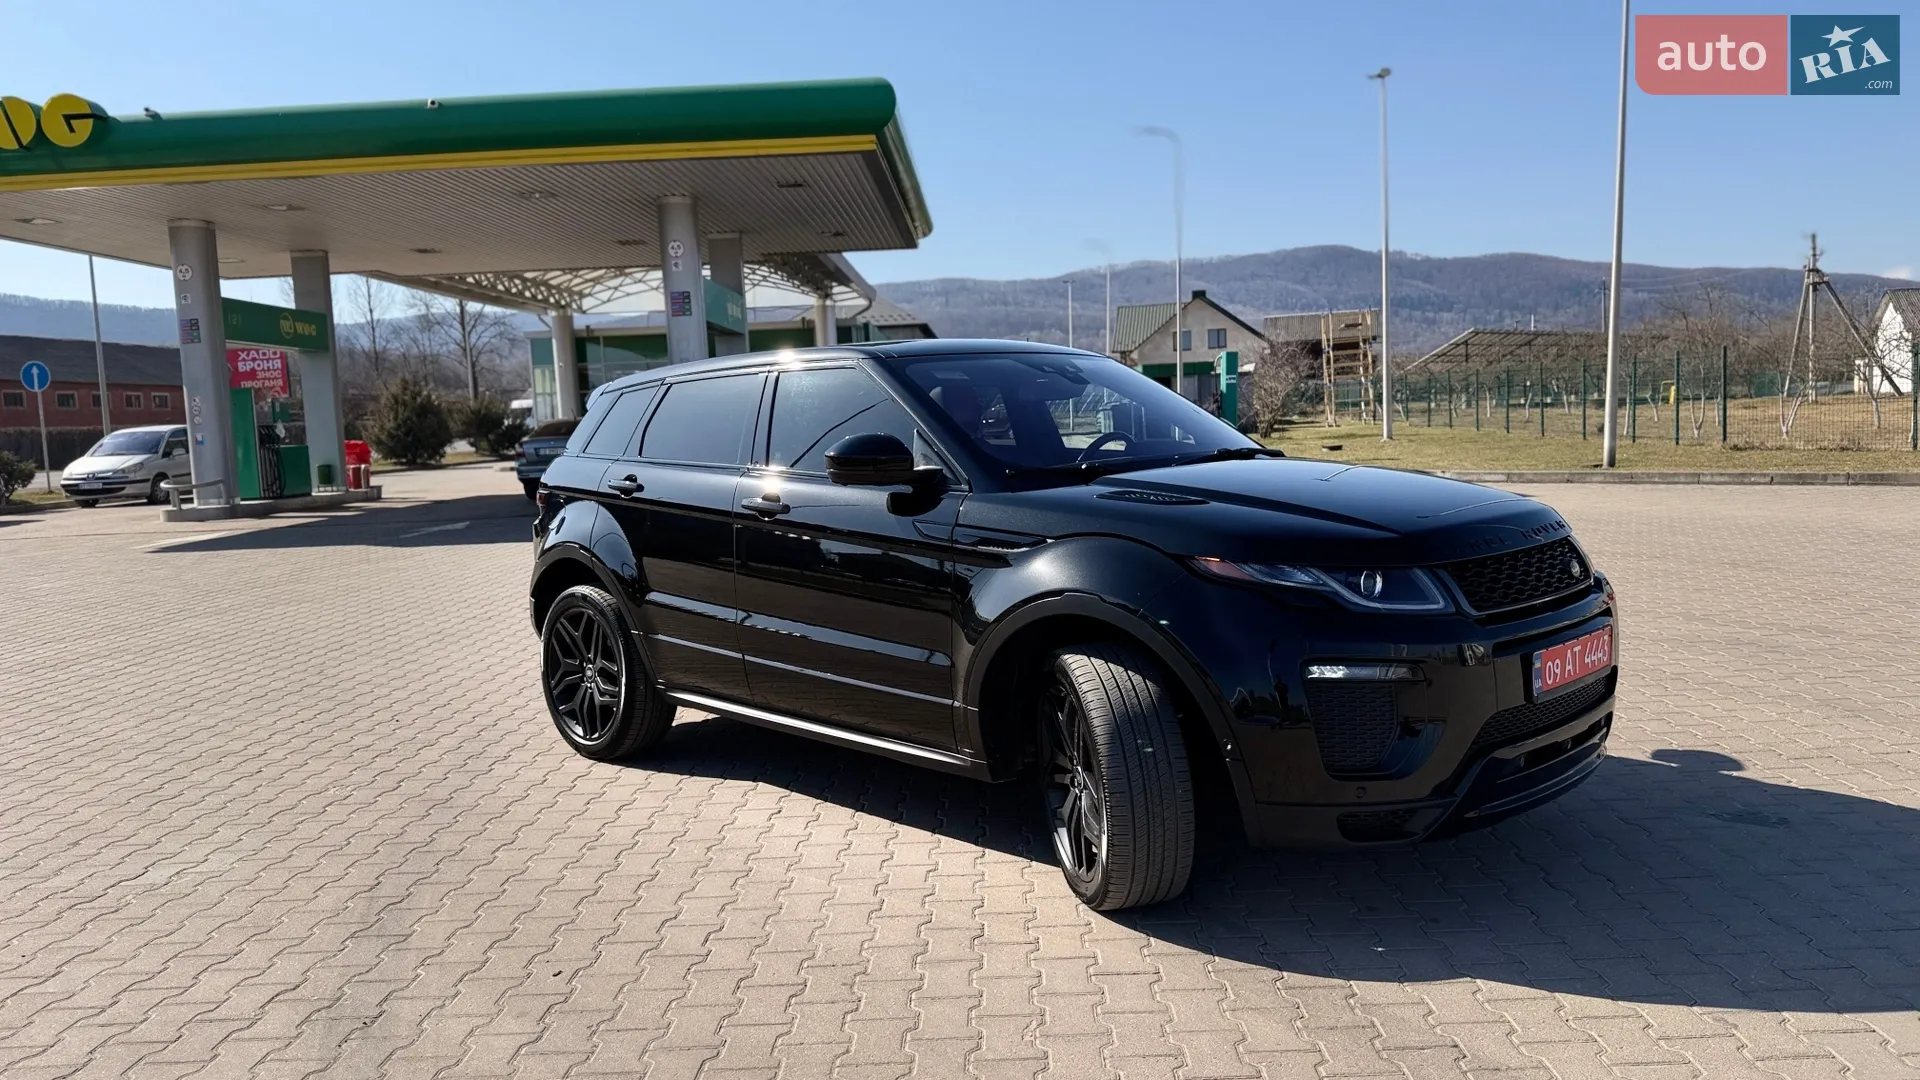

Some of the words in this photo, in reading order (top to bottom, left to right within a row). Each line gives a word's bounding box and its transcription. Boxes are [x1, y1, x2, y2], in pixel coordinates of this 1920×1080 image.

[237, 359, 281, 372] БРОНЯ
[256, 370, 282, 379] ЗНОС
[1545, 658, 1561, 685] 09
[1565, 645, 1581, 678] AT
[1584, 634, 1608, 669] 4443
[1534, 678, 1542, 689] UA
